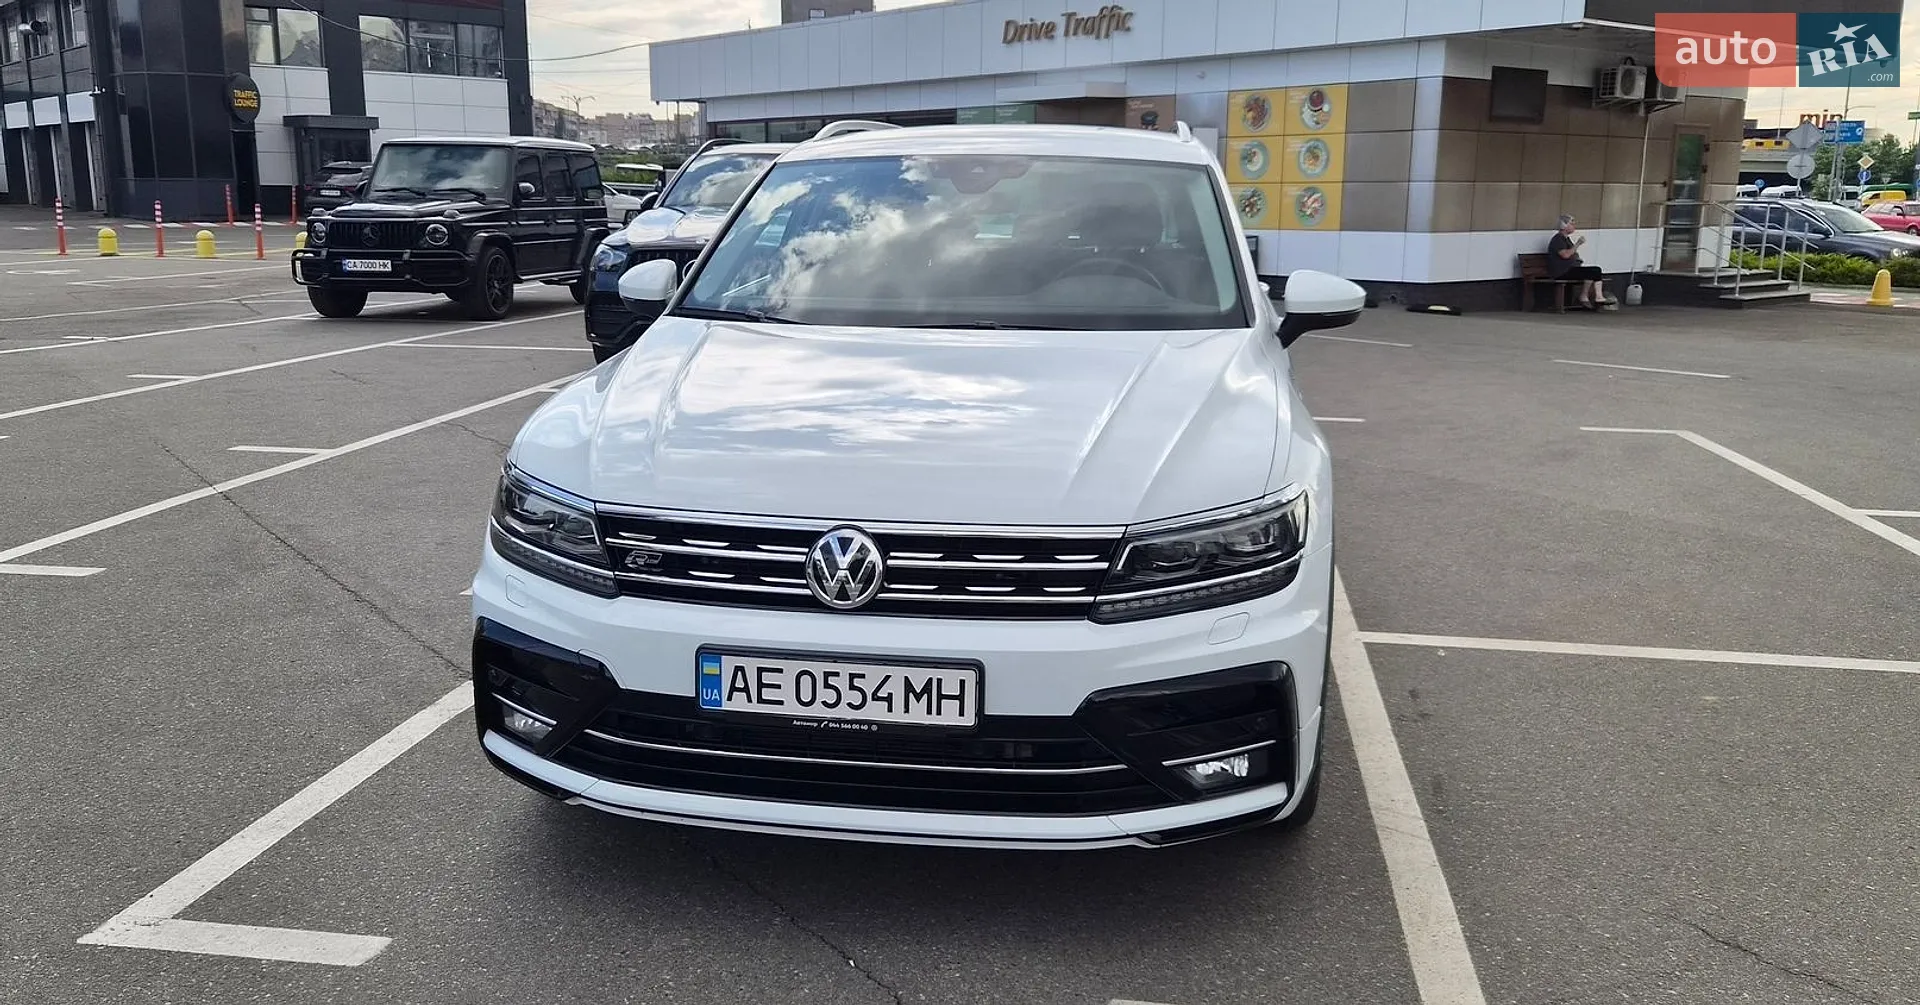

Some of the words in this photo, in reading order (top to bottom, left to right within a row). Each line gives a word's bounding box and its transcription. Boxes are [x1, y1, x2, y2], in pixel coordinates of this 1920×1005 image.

[1002, 17, 1056, 44] Drive
[1061, 4, 1133, 40] Traffic
[233, 89, 258, 99] TRAFFIC
[234, 99, 258, 108] LOUNGE
[347, 260, 358, 269] CA
[360, 260, 377, 269] 7000
[378, 260, 390, 270] HK
[703, 688, 720, 701] UA
[726, 664, 785, 706] AE
[794, 668, 894, 714] 0554
[903, 675, 966, 718] MH
